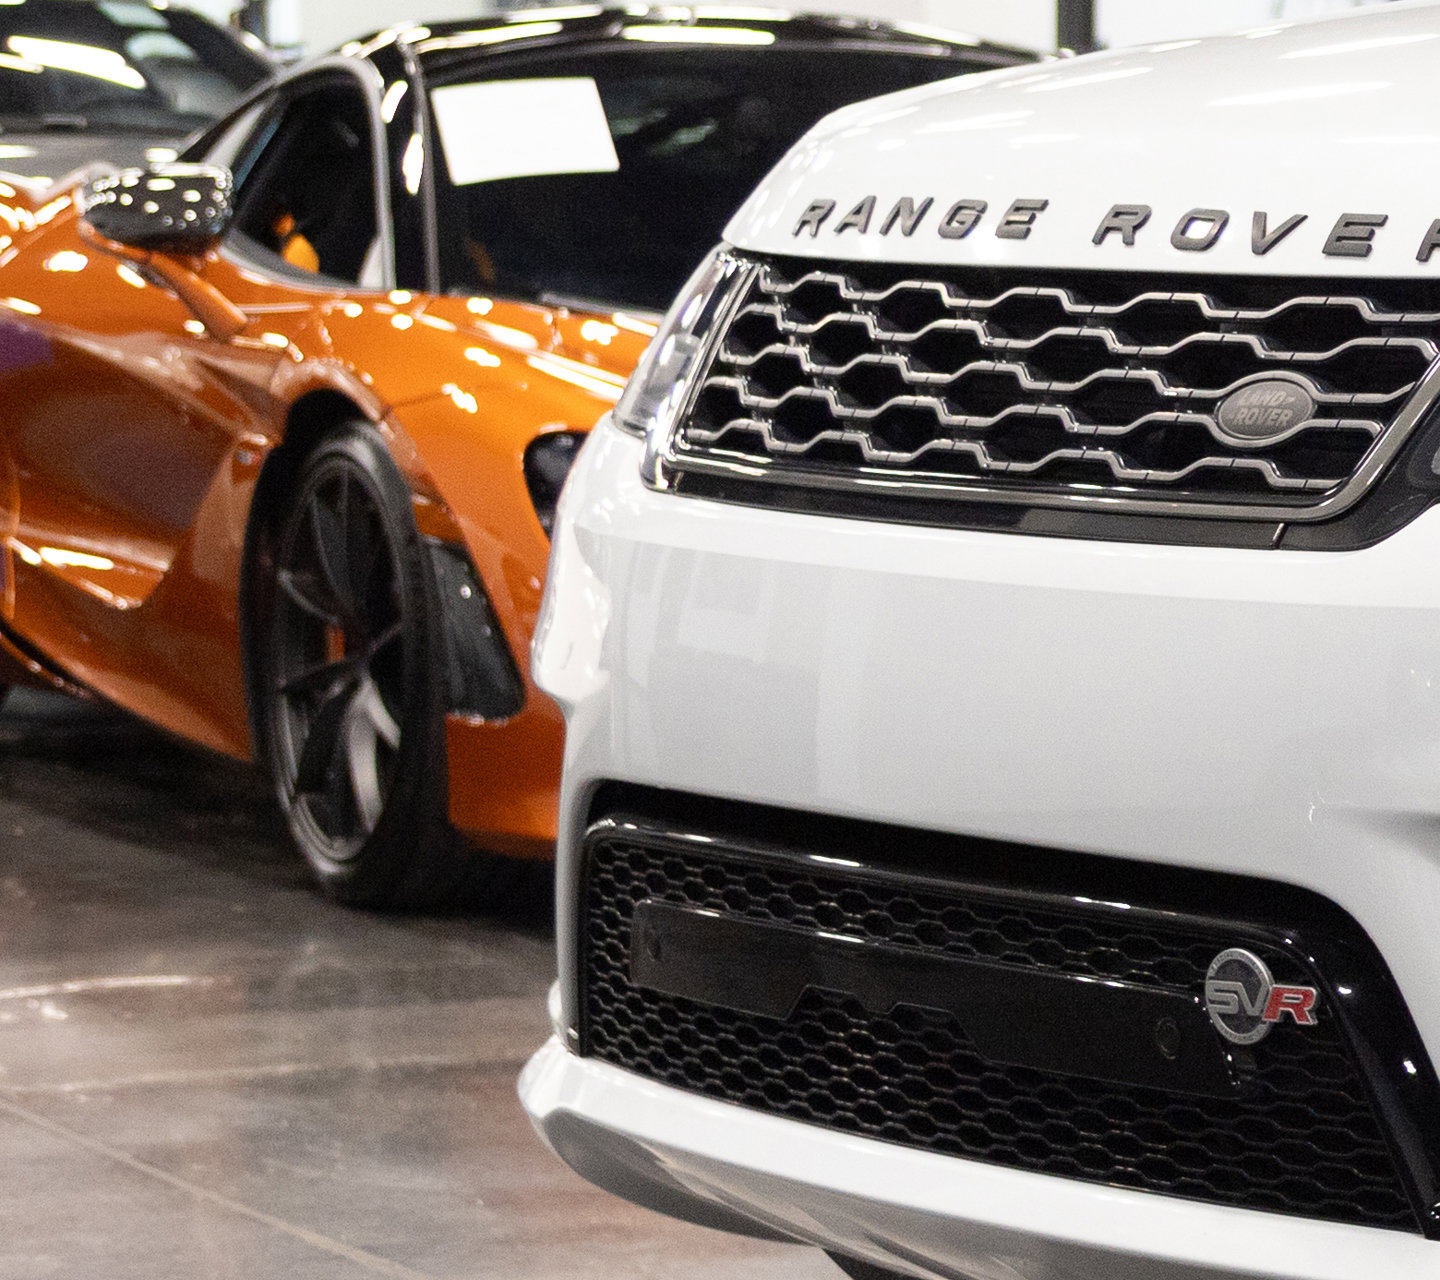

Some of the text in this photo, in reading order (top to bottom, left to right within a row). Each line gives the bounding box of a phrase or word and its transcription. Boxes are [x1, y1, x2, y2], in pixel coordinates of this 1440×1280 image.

[792, 194, 1049, 239] RANGE
[1234, 408, 1293, 426] ROVER
[1205, 978, 1318, 1026] SVR
